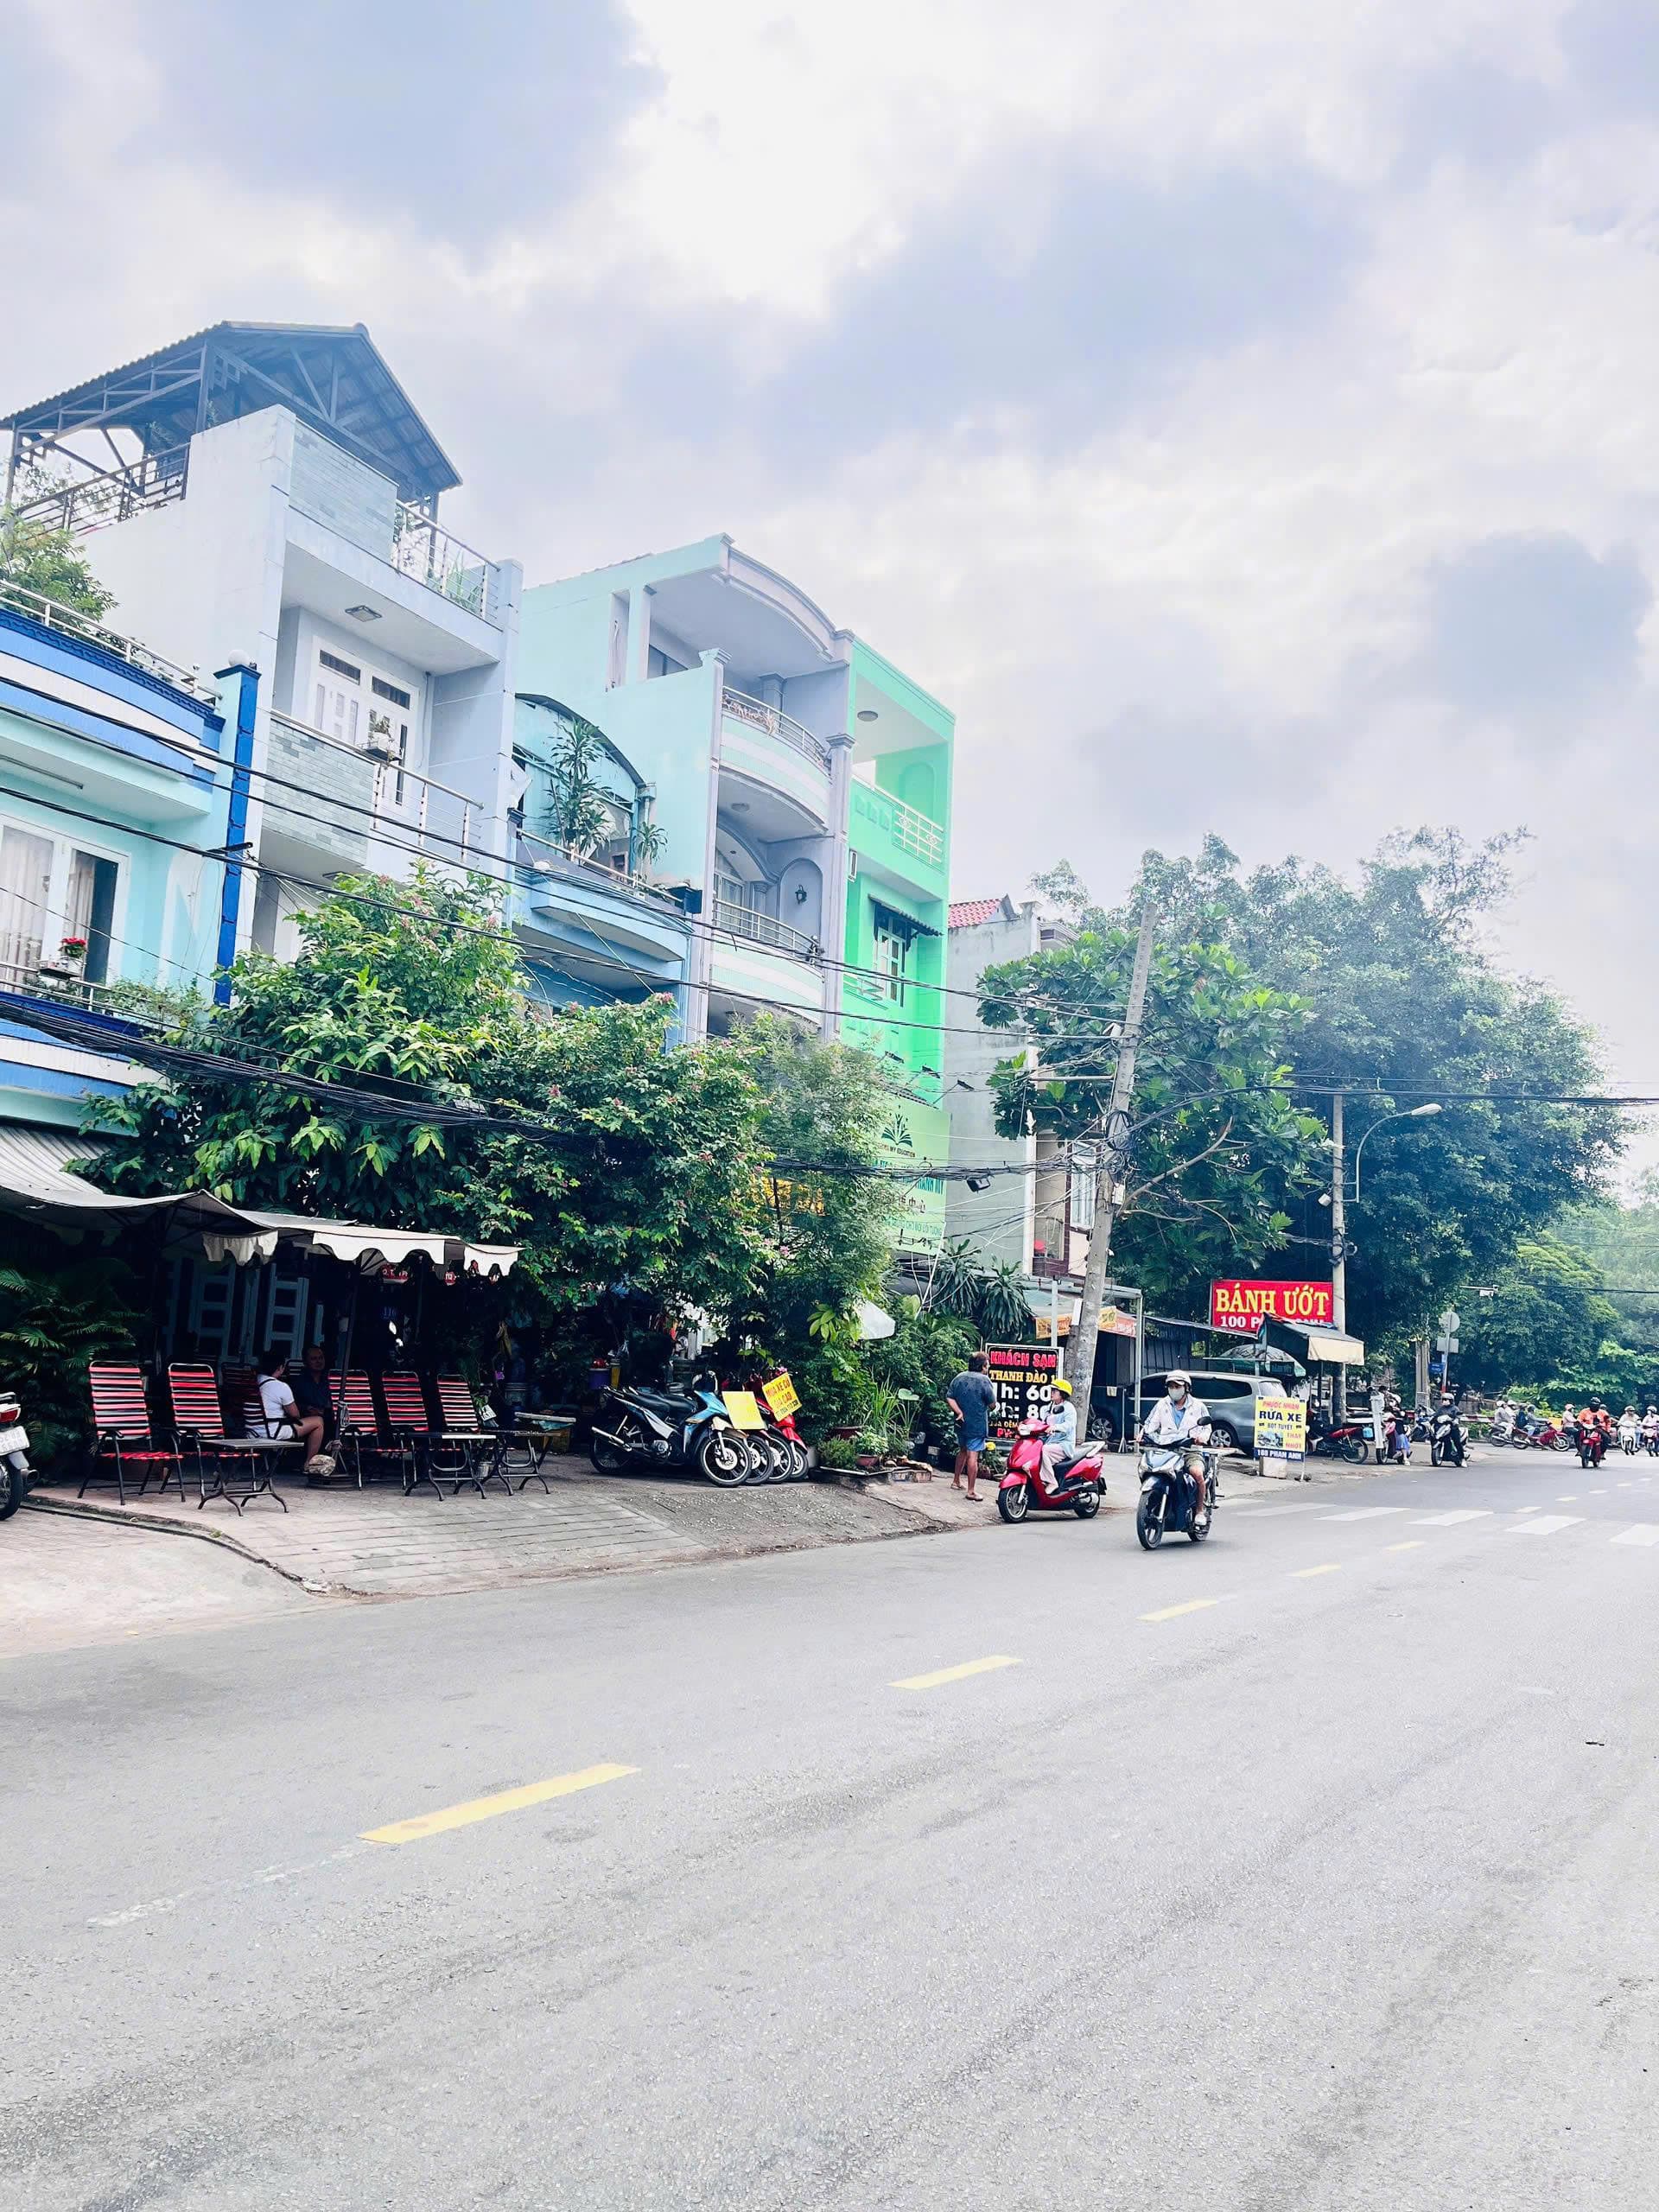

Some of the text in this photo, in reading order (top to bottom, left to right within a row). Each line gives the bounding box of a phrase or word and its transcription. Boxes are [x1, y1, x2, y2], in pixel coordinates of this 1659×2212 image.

[1216, 1282, 1330, 1316] BÁNH ƯỚT
[1220, 1315, 1247, 1328] 100
[990, 1349, 1057, 1370] KHÁCH SẠN
[988, 1370, 1024, 1382] THANH
[1025, 1369, 1048, 1384] ĐÀO
[1259, 1408, 1302, 1423] RỬA XE
